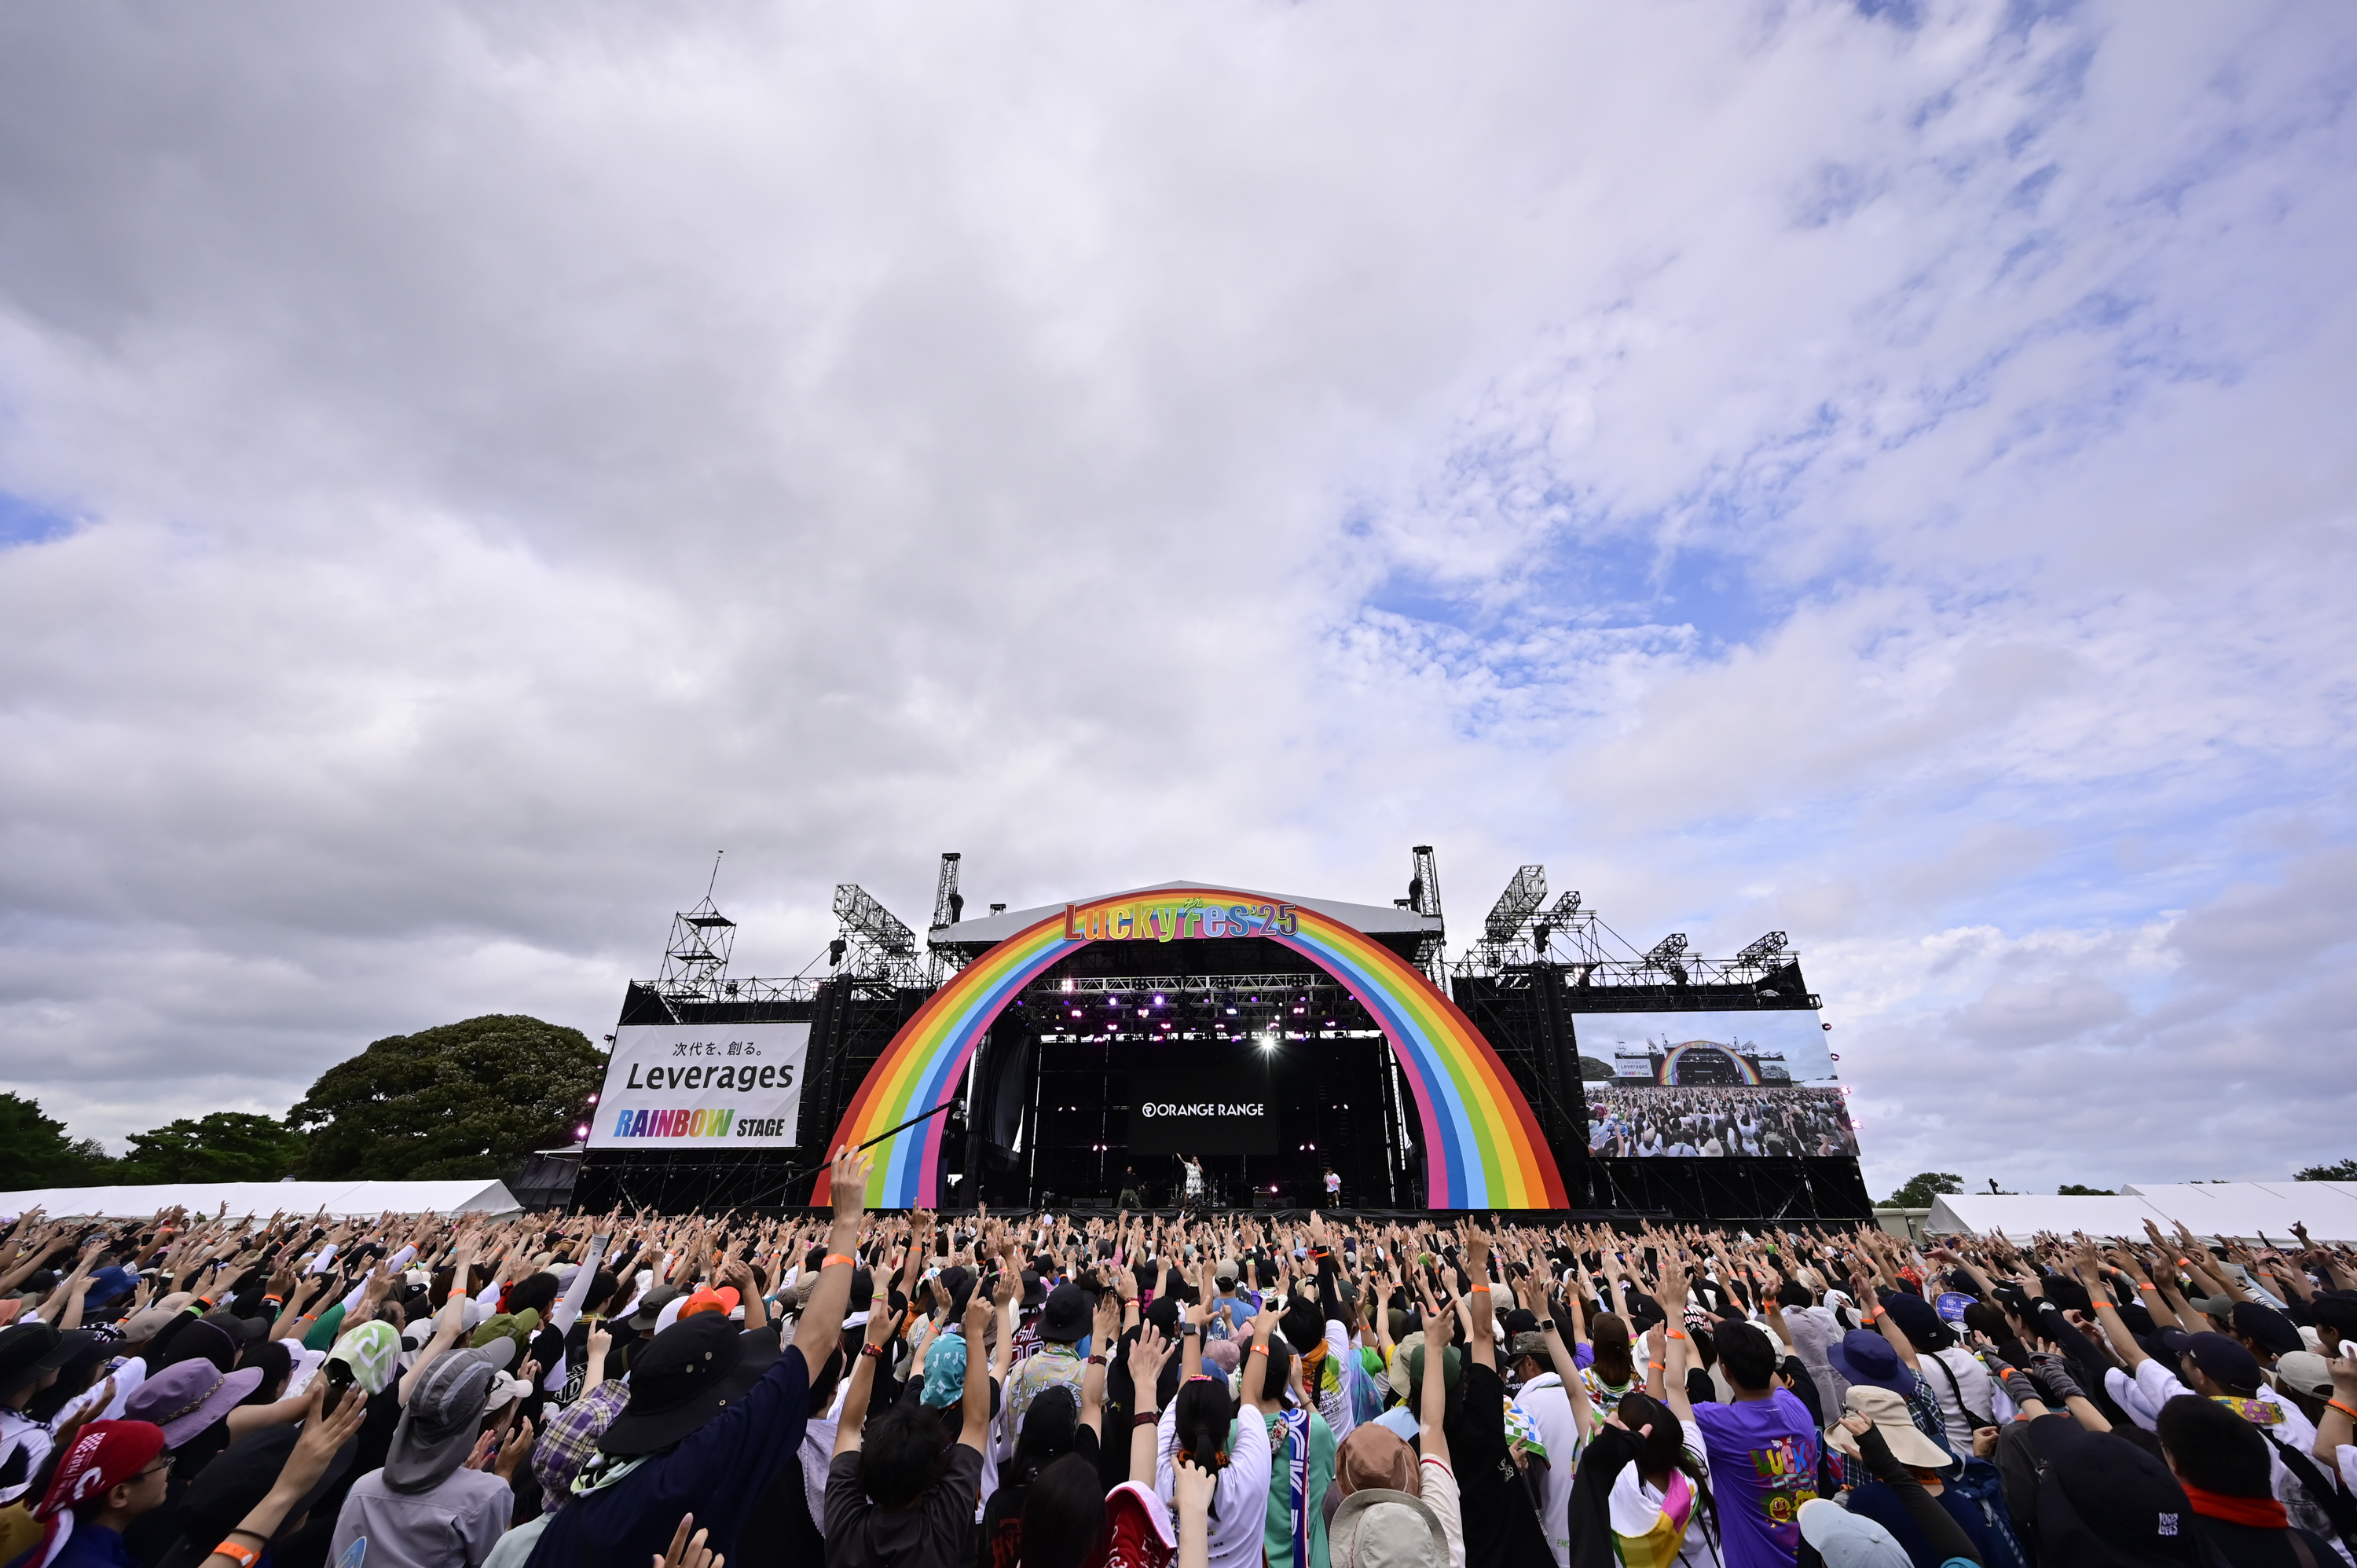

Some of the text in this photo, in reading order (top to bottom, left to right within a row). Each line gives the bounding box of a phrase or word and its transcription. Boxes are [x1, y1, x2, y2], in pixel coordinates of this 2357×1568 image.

[673, 1041, 762, 1057] 次代を、創る。
[626, 1063, 794, 1092] Leverages
[614, 1108, 785, 1138] RAINBOW STAGE
[1157, 1103, 1215, 1116] ORANGE
[1218, 1103, 1264, 1116] RANGE
[1011, 1379, 1051, 1409] Luck
[1750, 1441, 1816, 1477] LUCKY
[1771, 1471, 1812, 1493] FES
